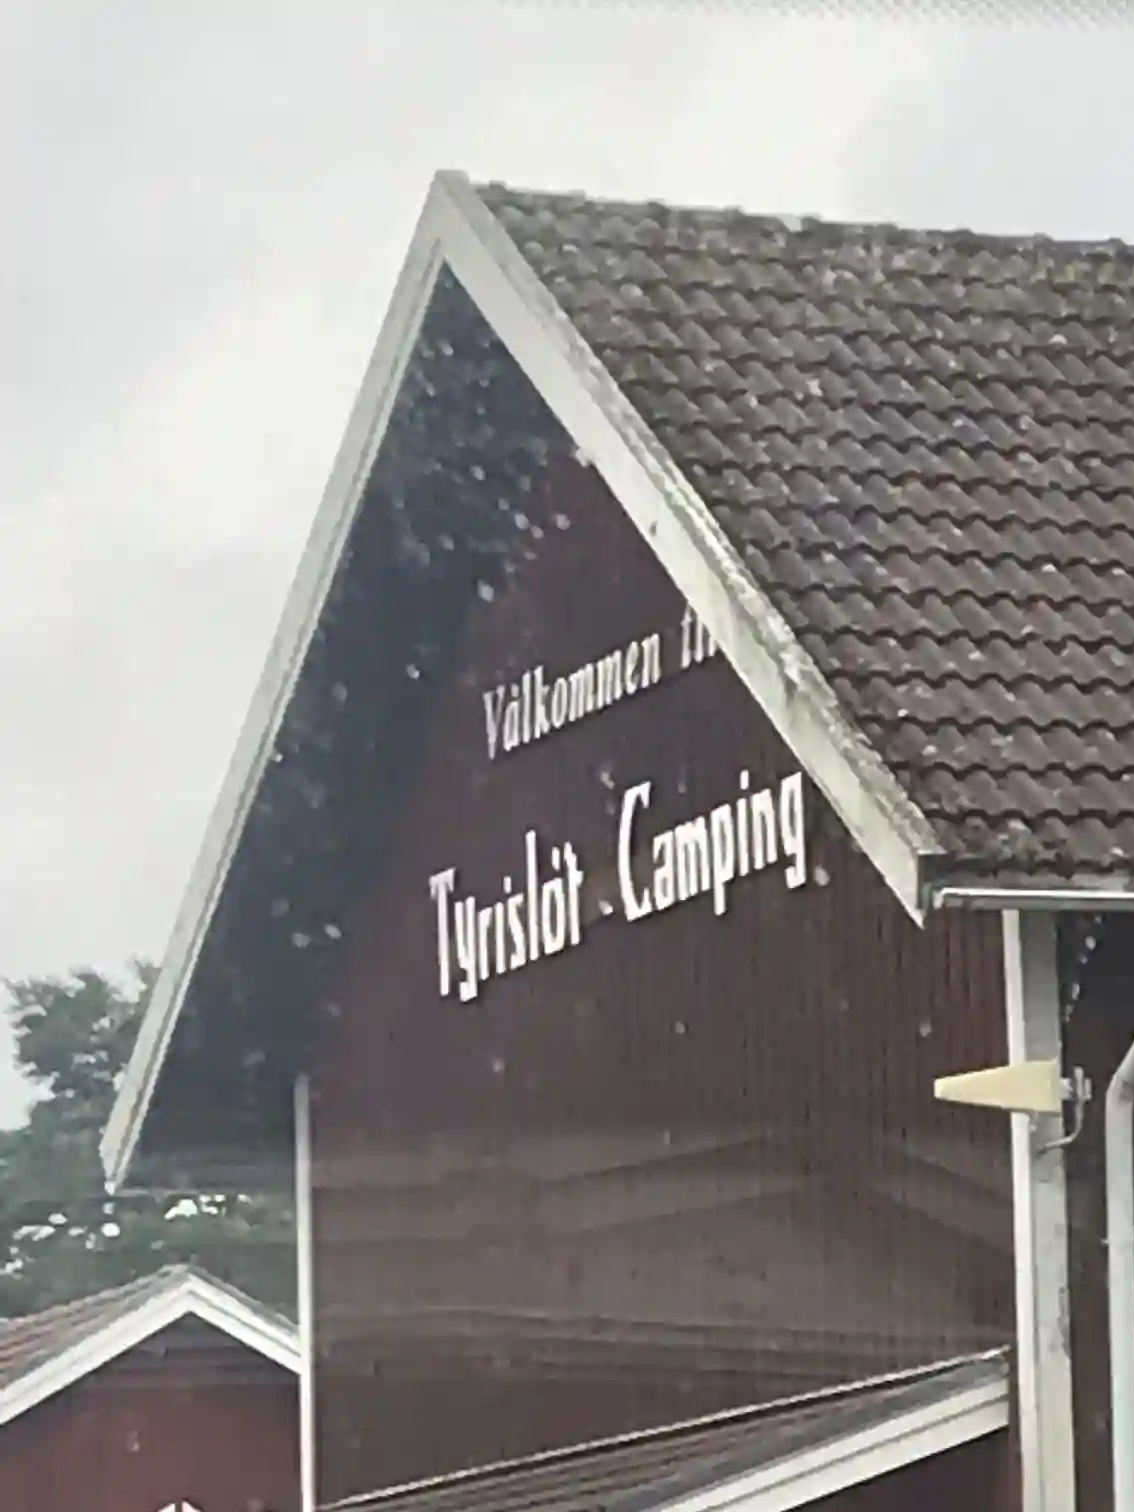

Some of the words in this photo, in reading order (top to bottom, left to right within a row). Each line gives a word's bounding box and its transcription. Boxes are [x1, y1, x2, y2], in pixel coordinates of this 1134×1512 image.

[484, 633, 662, 760] Välkommen
[429, 829, 585, 1002] Tyrislöt
[618, 769, 807, 922] Camping
